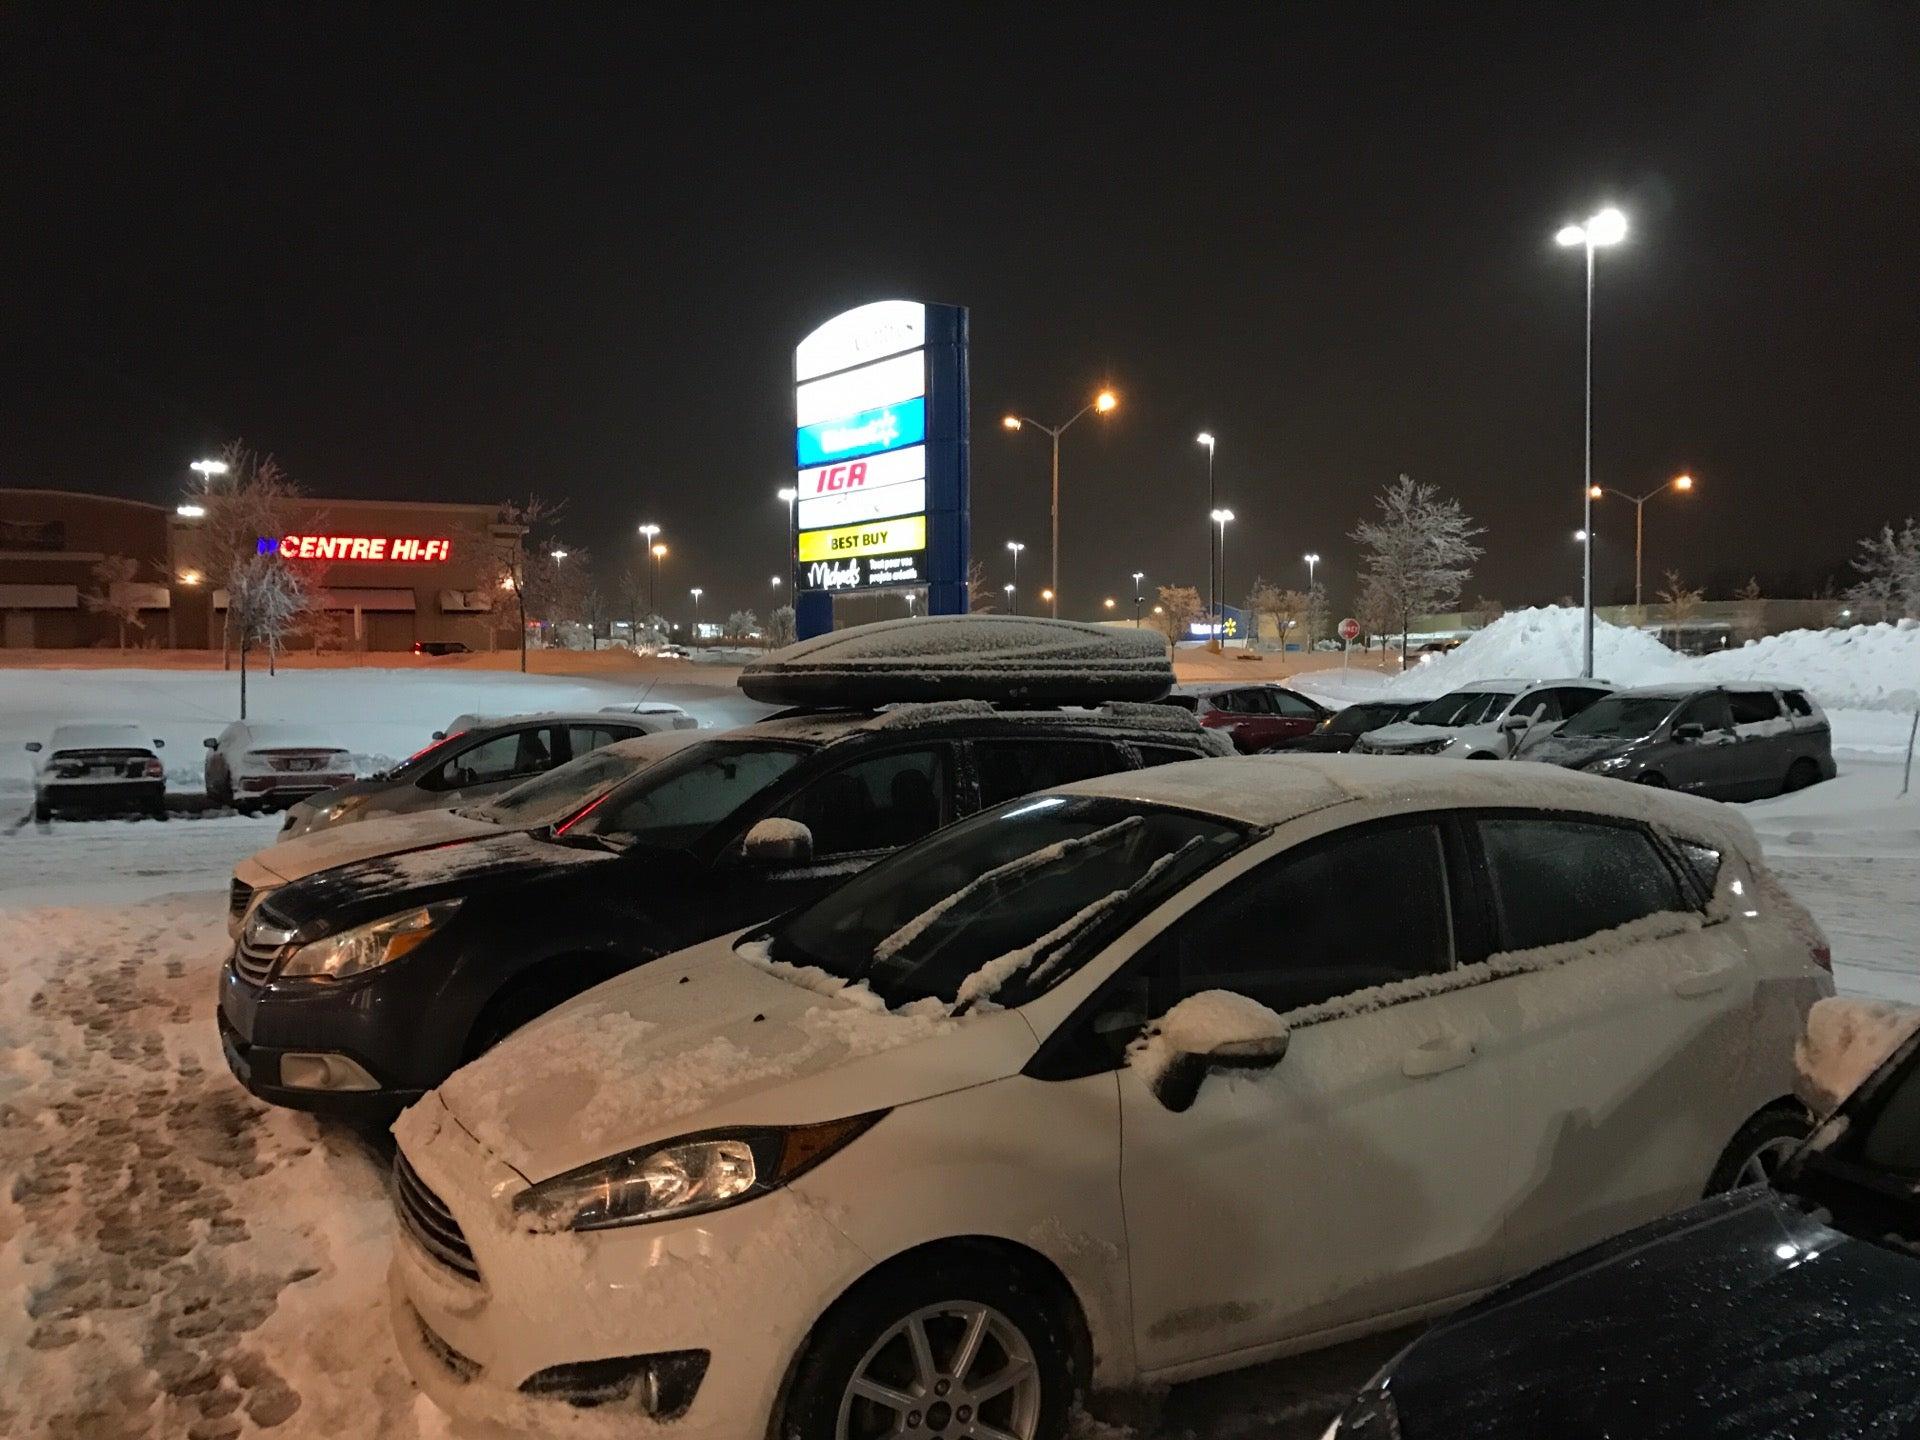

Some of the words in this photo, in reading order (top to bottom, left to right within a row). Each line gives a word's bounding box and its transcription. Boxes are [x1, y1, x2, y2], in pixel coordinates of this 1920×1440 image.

[816, 462, 868, 493] IGA
[280, 536, 387, 559] CENTRE
[391, 539, 449, 561] HI-FI
[831, 536, 859, 550] BEST
[862, 531, 888, 546] BUY
